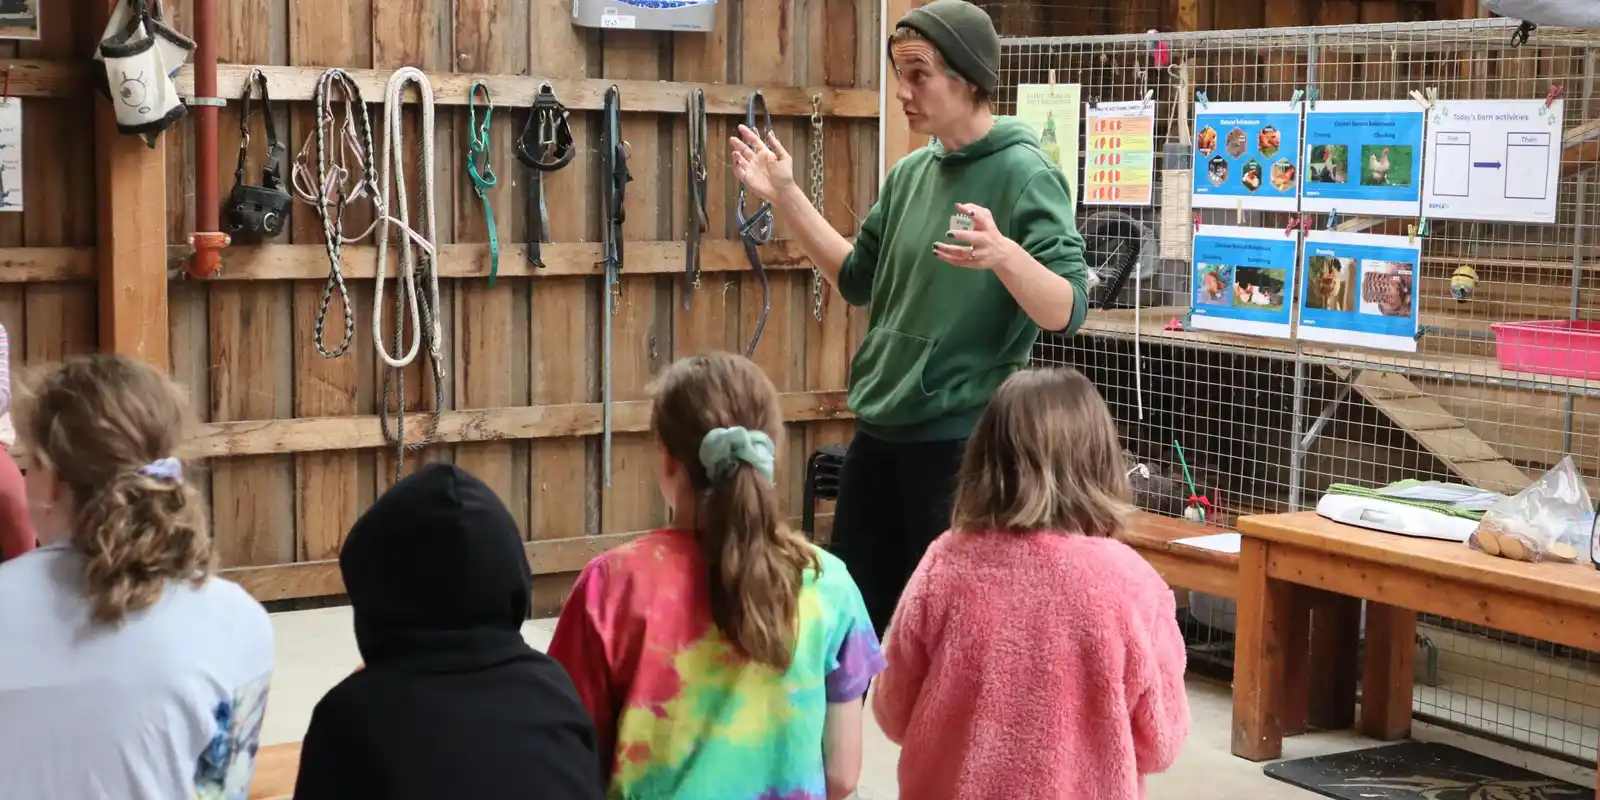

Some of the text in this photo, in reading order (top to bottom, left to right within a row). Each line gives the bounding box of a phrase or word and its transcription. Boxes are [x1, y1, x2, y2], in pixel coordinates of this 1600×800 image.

[1453, 113, 1529, 123] Today's barn activities
